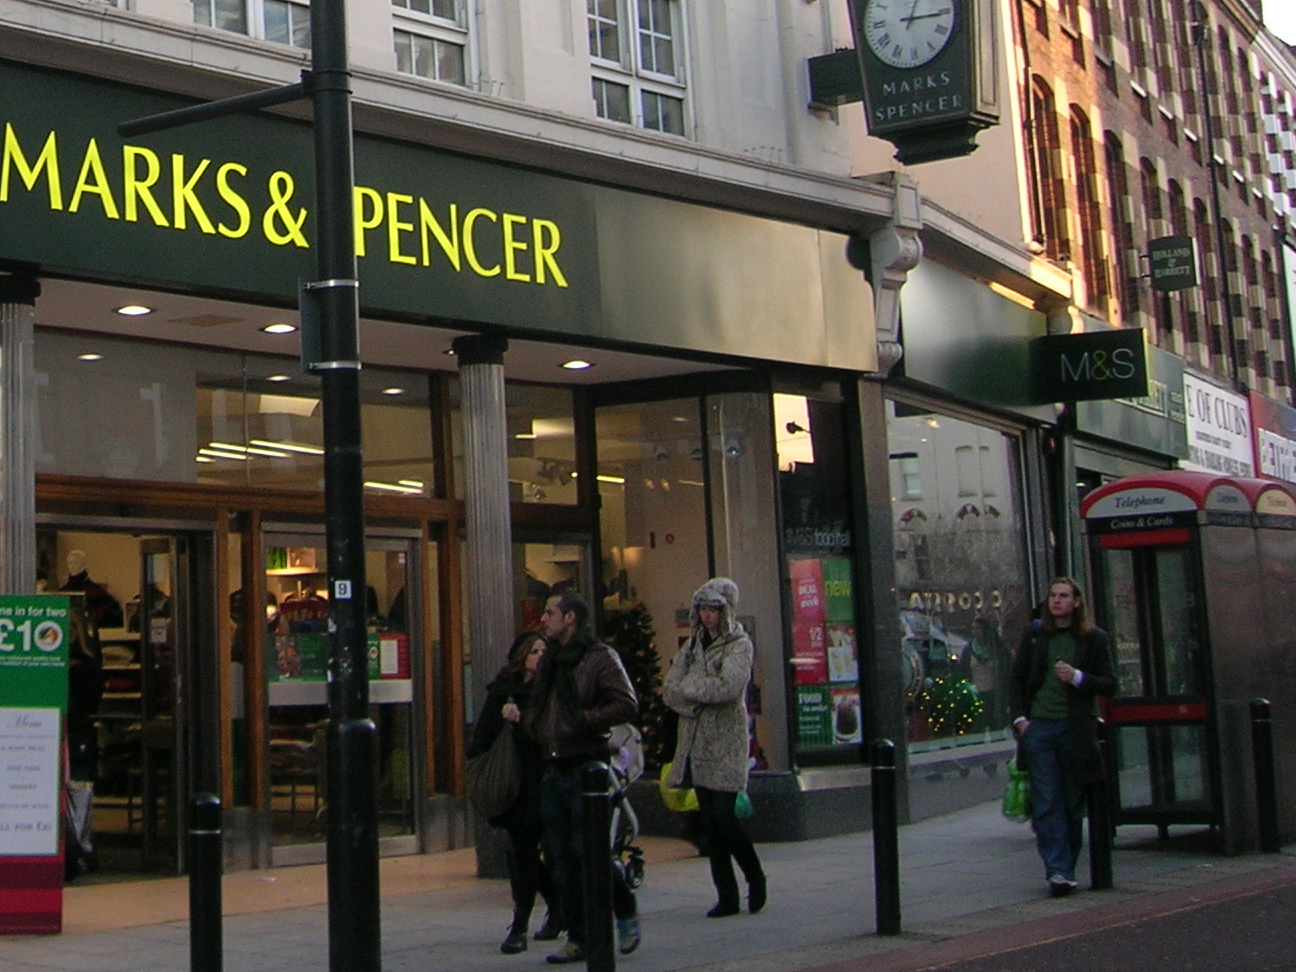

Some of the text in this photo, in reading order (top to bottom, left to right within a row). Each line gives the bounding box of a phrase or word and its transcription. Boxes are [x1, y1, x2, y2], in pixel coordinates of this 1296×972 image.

[883, 71, 951, 95] MARKS
[875, 95, 963, 121] SPENCER
[0, 122, 568, 288] MARKS & PENCER
[1060, 348, 1135, 382] M&S
[1196, 388, 1211, 424] OF
[1214, 396, 1248, 438] CLUBS
[1114, 494, 1166, 510] Telephone
[1110, 518, 1136, 530] Coins
[1146, 515, 1174, 527] Cards
[825, 580, 851, 597] new
[15, 605, 25, 616] in
[27, 605, 44, 616] for
[46, 606, 66, 617] two
